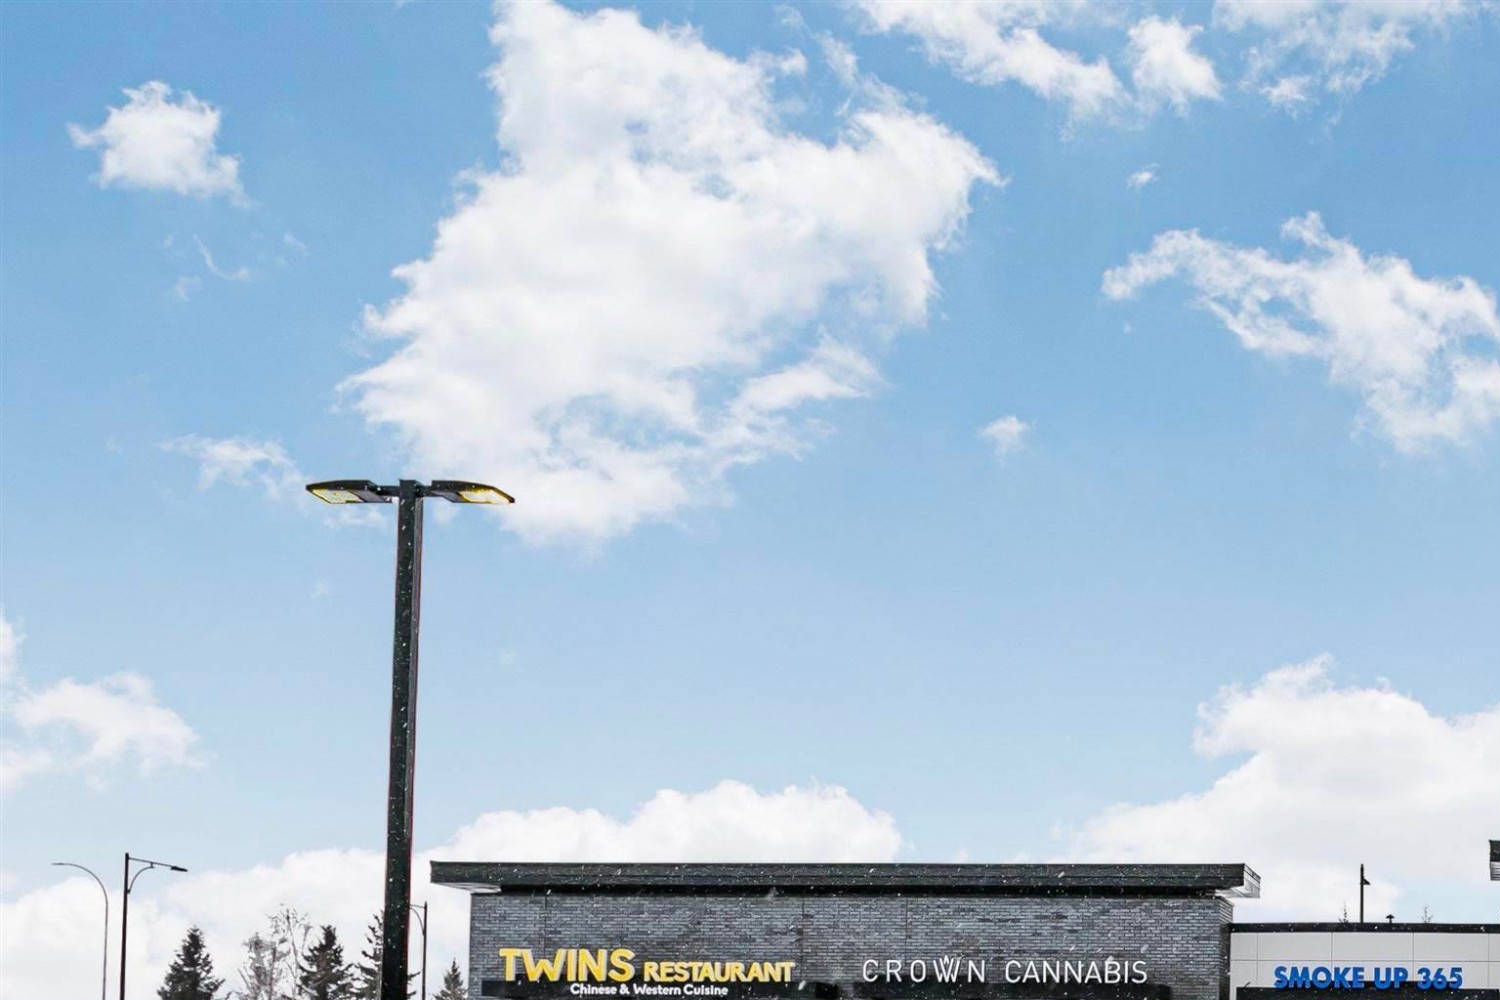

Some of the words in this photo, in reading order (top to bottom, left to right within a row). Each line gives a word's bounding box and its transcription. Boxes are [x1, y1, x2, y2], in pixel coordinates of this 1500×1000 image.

[499, 948, 636, 982] TWINS
[643, 961, 796, 982] RESTAURANT
[862, 954, 986, 983] CROWN
[1005, 959, 1148, 984] CANNABIS
[1274, 966, 1365, 989] SMOKE
[1374, 967, 1409, 989] UP
[1417, 967, 1463, 990] 365
[570, 983, 617, 995] Chinese
[619, 984, 630, 995] &
[633, 984, 682, 995] Western
[683, 984, 729, 996] Cuisine
